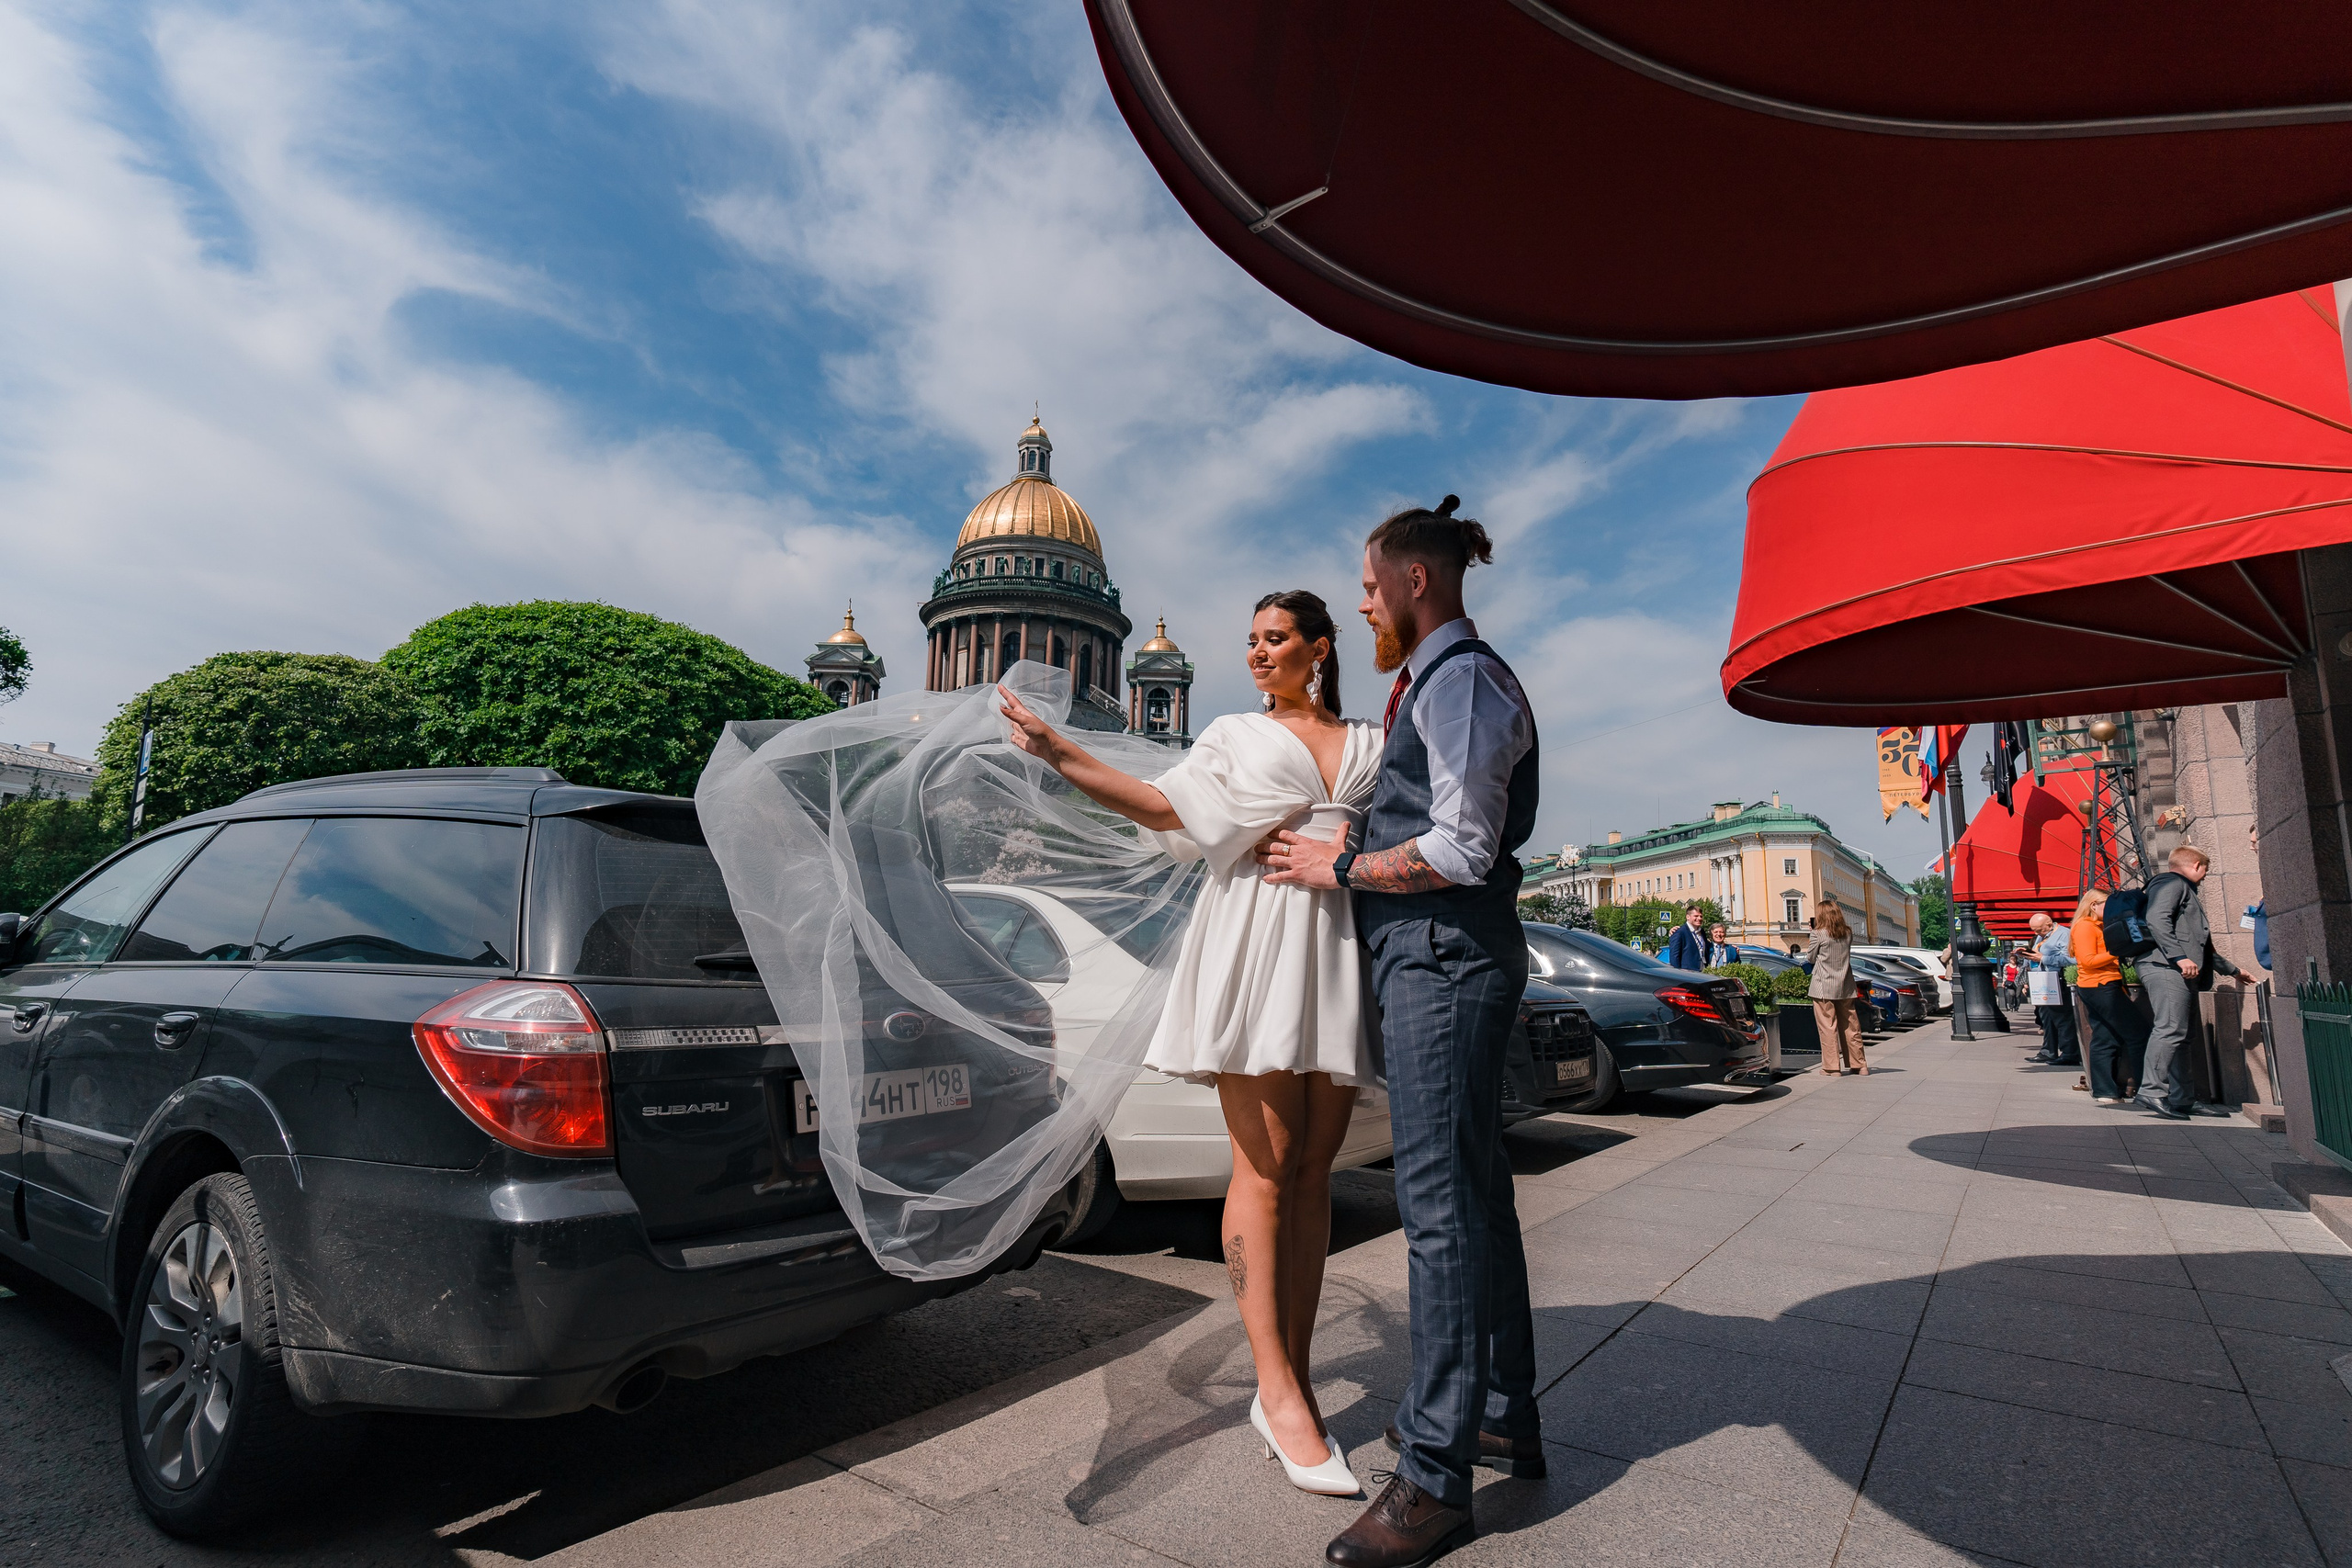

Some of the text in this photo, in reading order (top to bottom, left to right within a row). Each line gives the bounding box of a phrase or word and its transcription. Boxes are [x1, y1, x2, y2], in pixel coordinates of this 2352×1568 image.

[927, 1068, 964, 1098] 198
[642, 1101, 729, 1116] SUBARU
[936, 1097, 956, 1108] RUS
